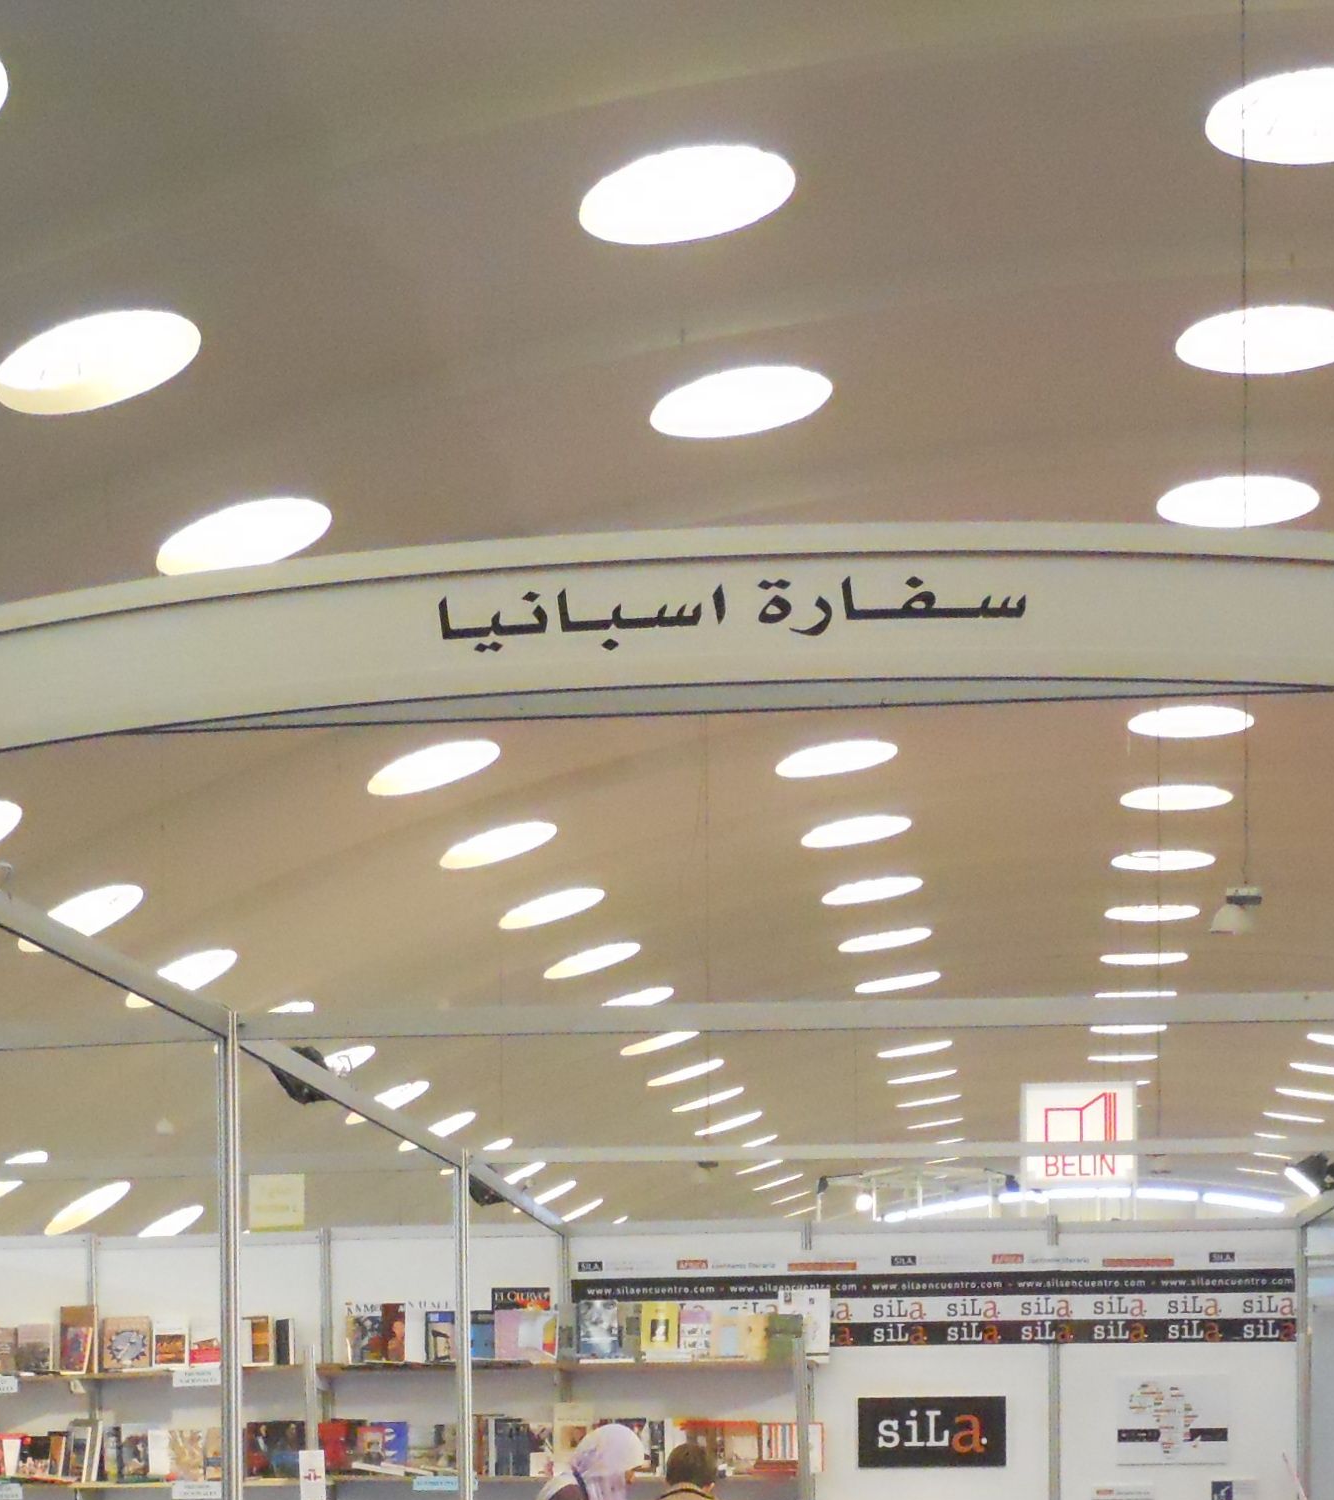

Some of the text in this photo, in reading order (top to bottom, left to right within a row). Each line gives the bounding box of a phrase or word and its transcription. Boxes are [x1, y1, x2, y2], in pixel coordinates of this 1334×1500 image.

[438, 575, 1027, 653] سفارة اسبانيا
[1044, 1154, 1116, 1177] BELIN
[878, 1409, 988, 1454] siLa.
